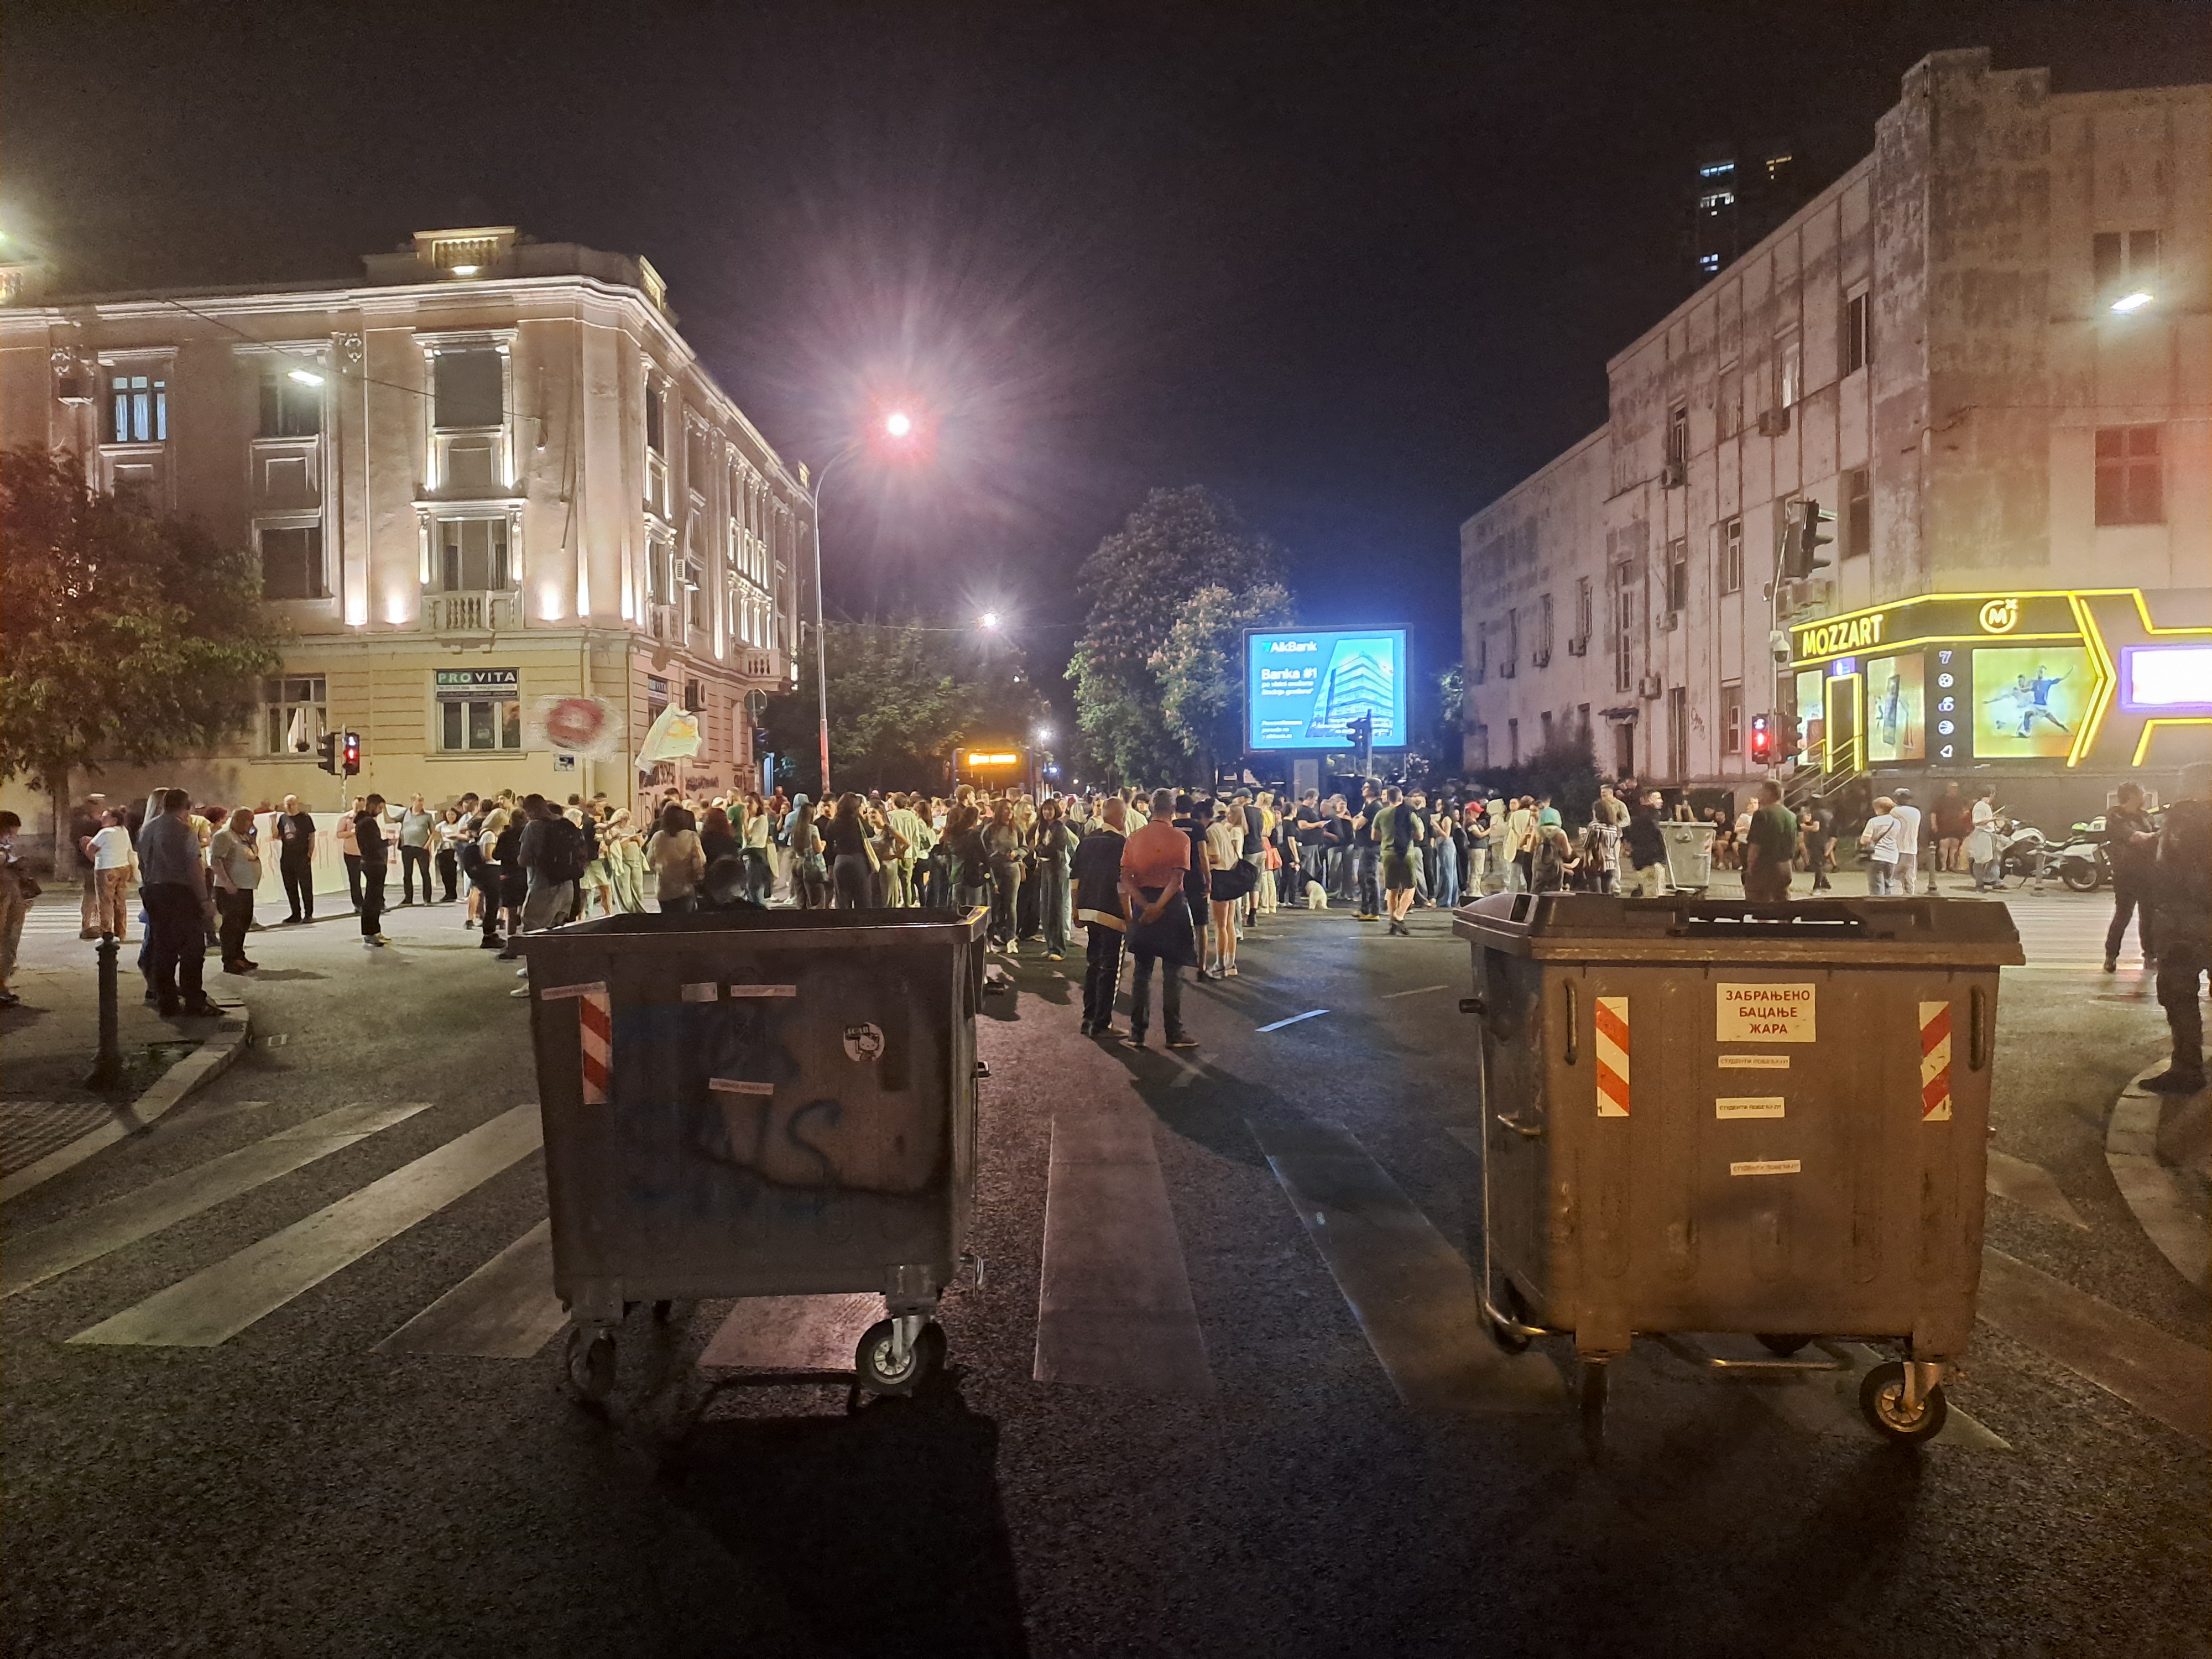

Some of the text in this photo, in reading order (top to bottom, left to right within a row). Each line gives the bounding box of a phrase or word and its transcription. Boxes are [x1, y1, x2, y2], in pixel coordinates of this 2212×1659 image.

[1802, 614, 1884, 657] MOZZART
[438, 672, 515, 683] PRO VITA
[1261, 668, 1300, 680] Banka
[1725, 990, 1810, 1001] ЗАБРАЊЕНО
[1739, 1007, 1798, 1019] БАЦАЊЕ
[1750, 1024, 1788, 1034] ЖАРА
